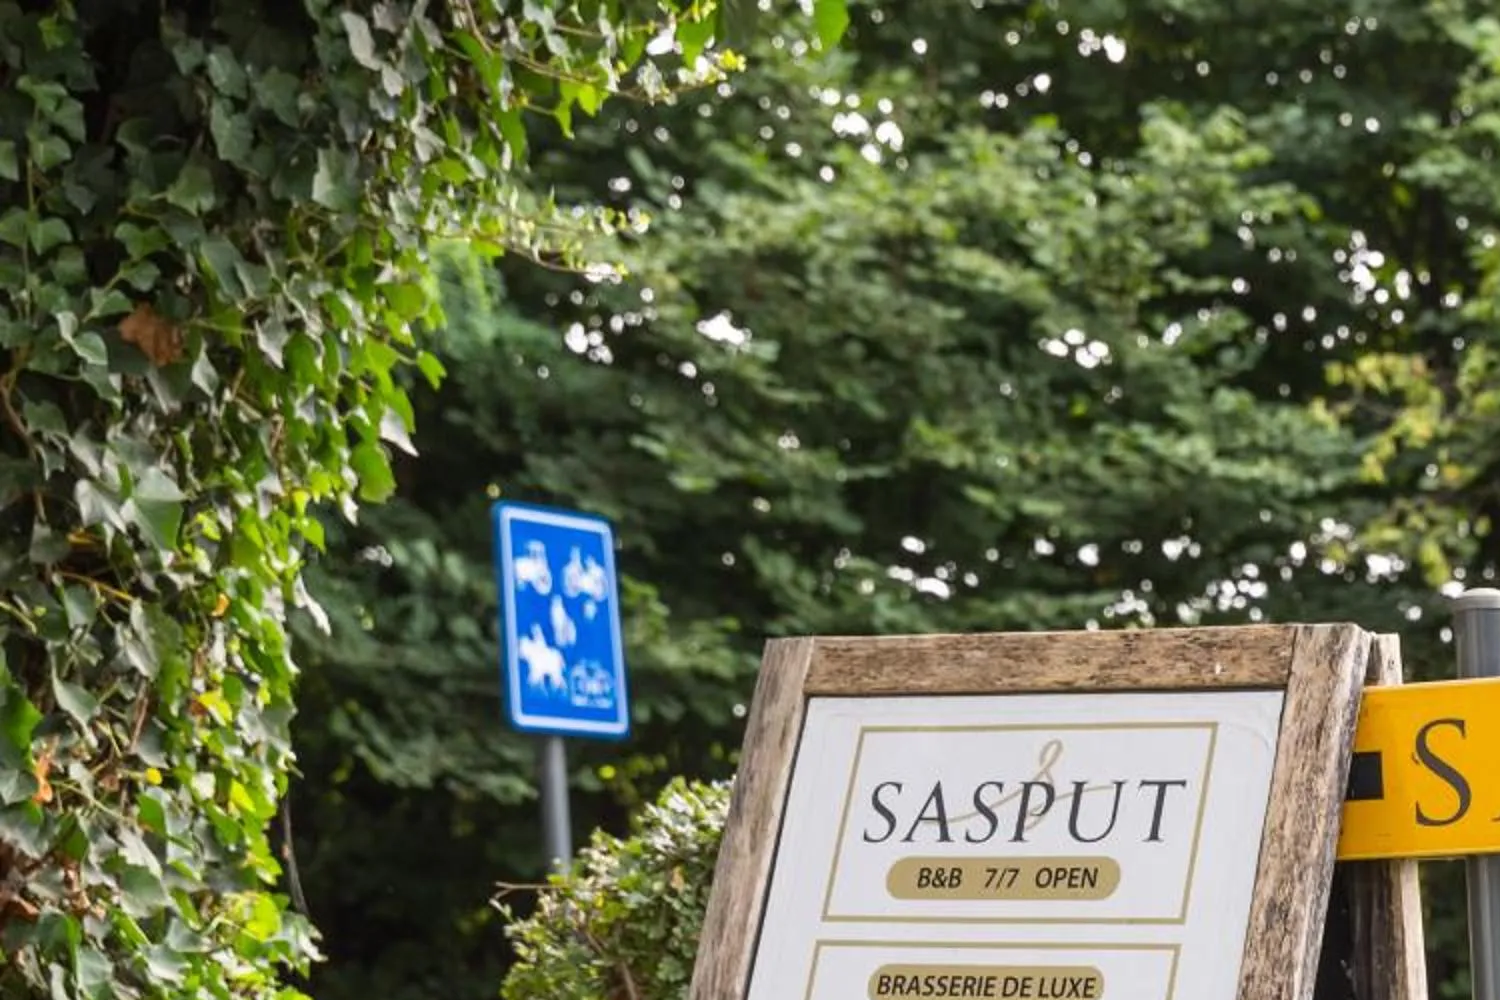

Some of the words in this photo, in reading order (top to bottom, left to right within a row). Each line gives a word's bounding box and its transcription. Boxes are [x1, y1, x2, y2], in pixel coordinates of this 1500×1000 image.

[864, 780, 1186, 843] SASPUT
[918, 868, 962, 888] B&B
[985, 868, 1020, 889] 7/7
[1035, 867, 1098, 888] OPEN
[877, 975, 997, 997] BRASSERIE
[1002, 976, 1033, 998] DE
[1038, 977, 1096, 998] LUXE
